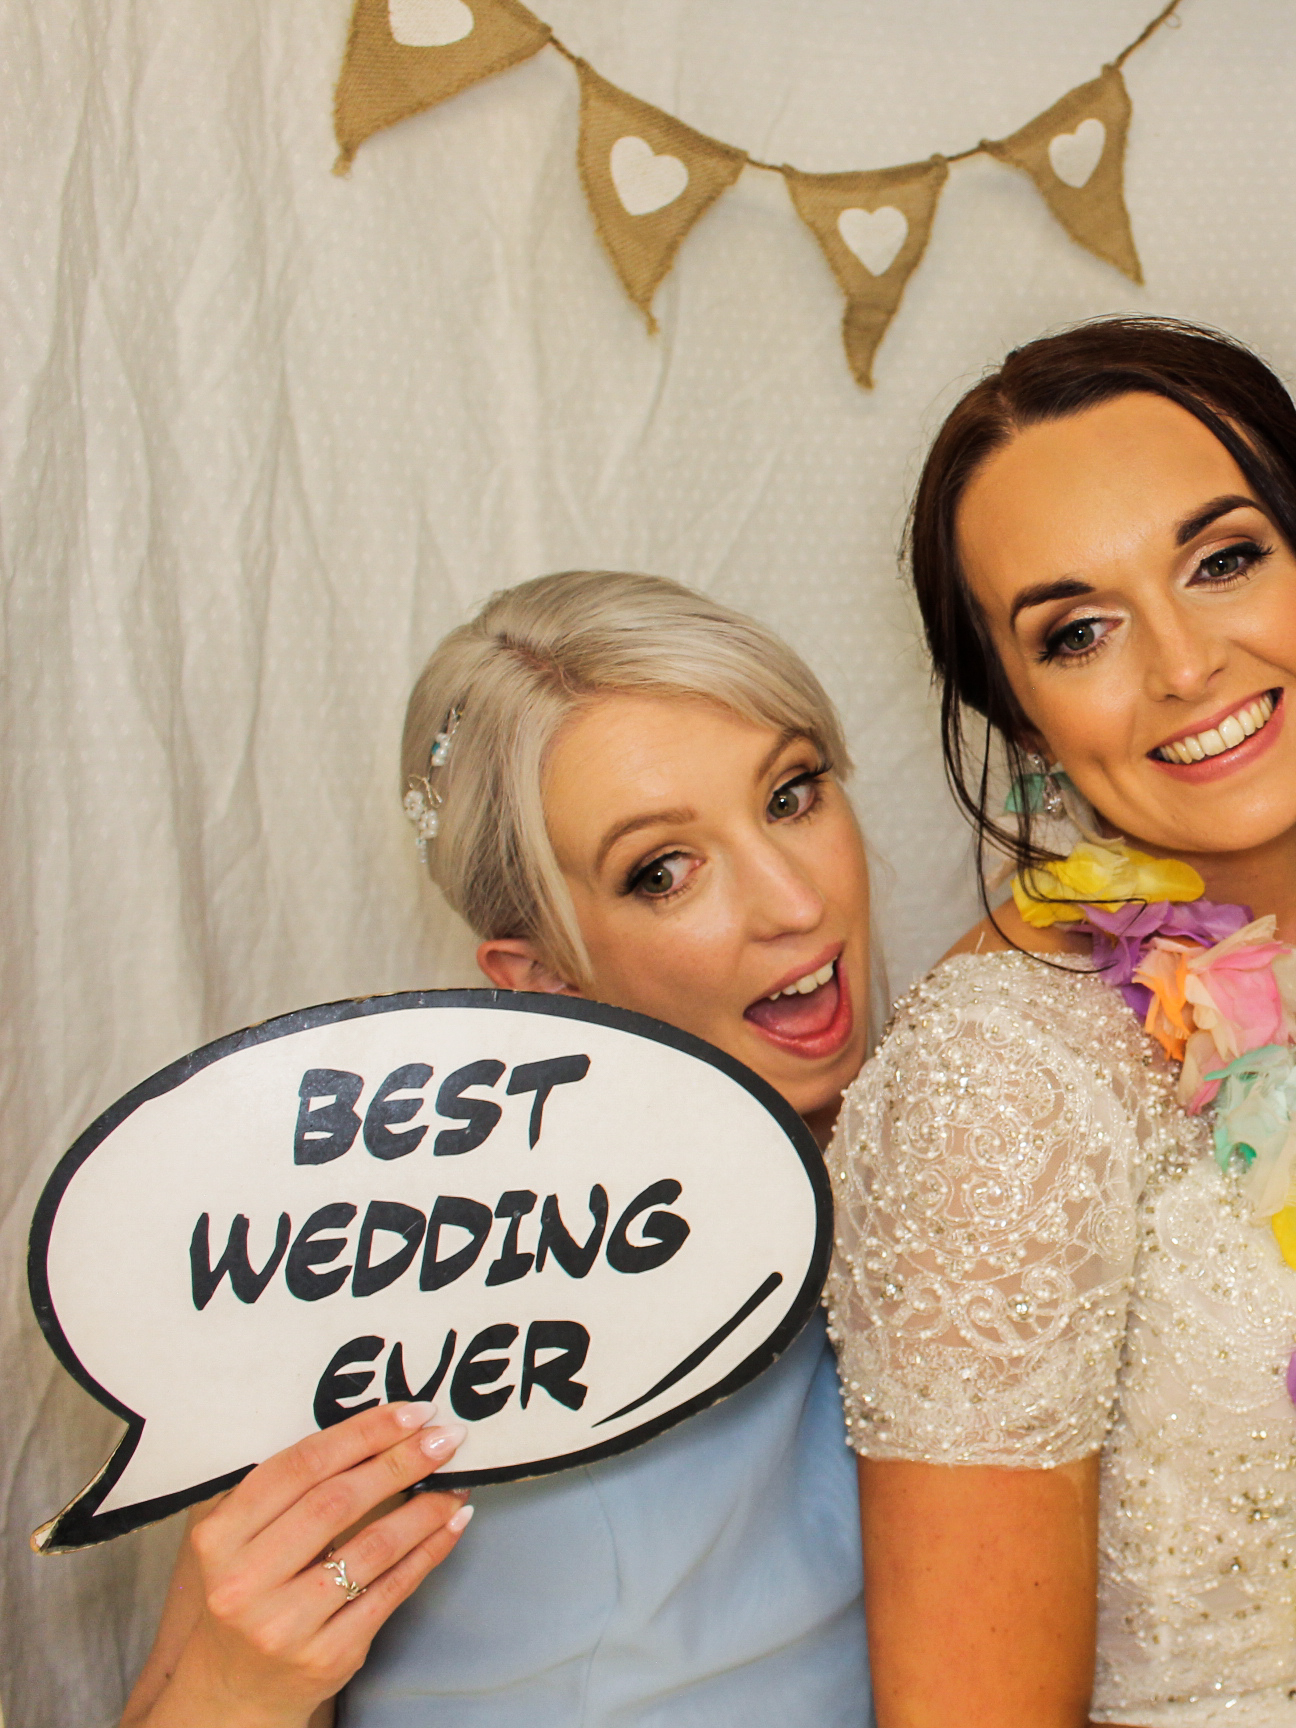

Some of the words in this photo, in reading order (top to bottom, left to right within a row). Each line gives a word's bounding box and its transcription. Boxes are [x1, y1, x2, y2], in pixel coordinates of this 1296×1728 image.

[293, 1053, 591, 1166] BEST
[189, 1178, 691, 1311] WEDDING
[312, 1319, 591, 1431] EVER
